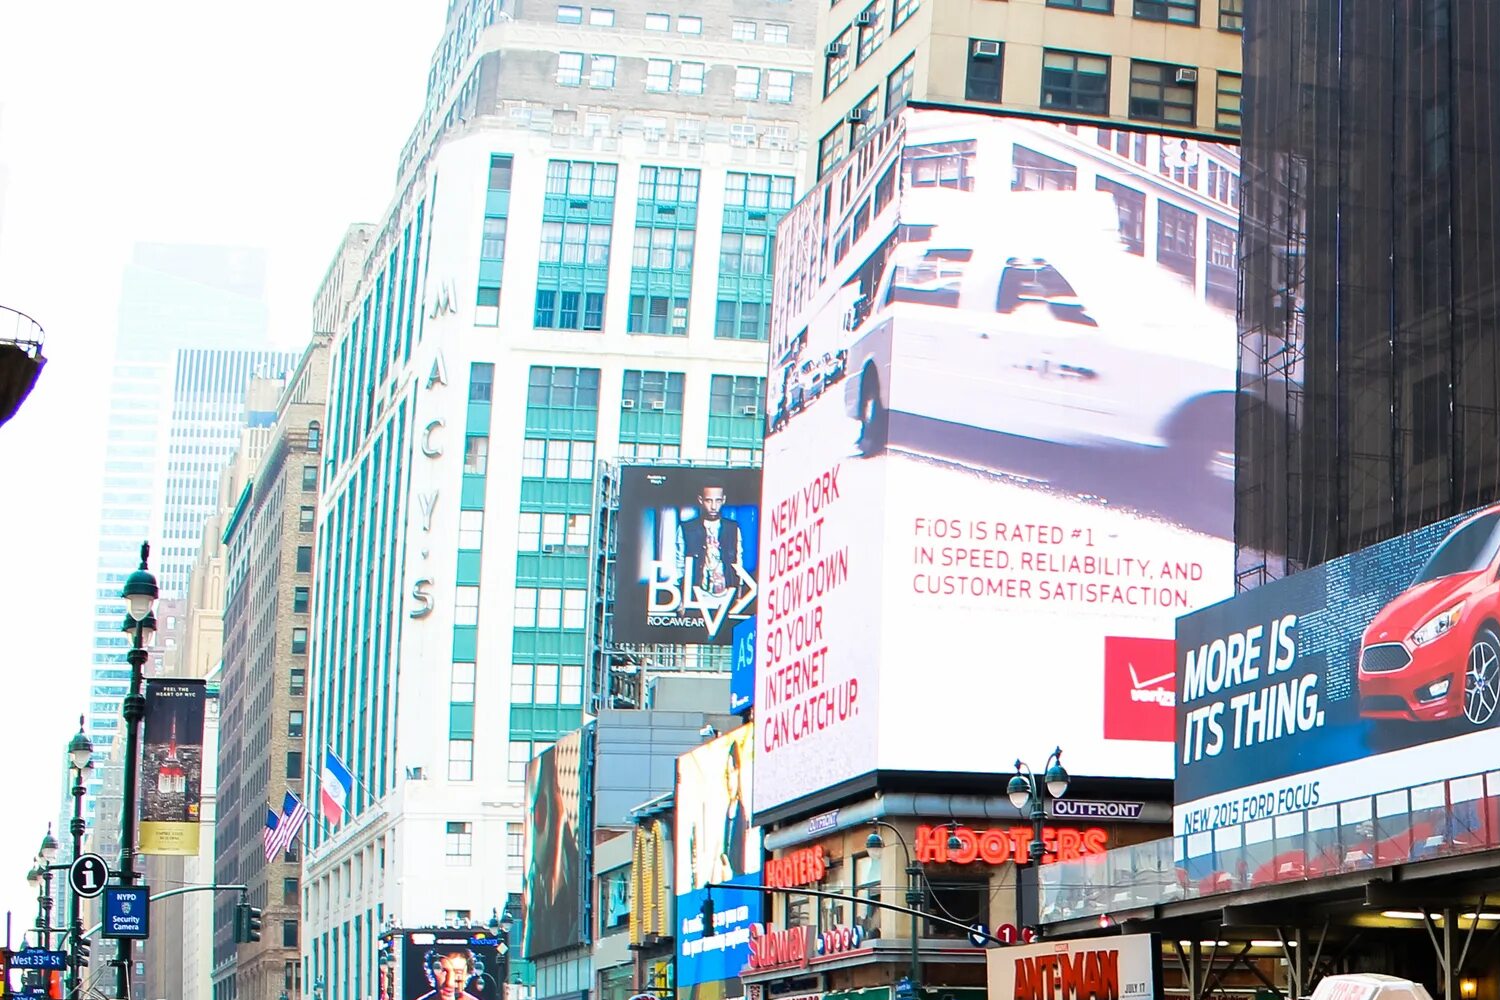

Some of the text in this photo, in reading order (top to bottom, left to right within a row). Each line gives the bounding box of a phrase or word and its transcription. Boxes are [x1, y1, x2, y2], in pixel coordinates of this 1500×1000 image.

[770, 463, 841, 542] NEW YORK
[768, 517, 825, 583] DOESN'T
[914, 518, 1096, 548] FiOS IS RATED #1
[913, 546, 1204, 582] IN SPEED, RELIABILITY, AND
[766, 546, 849, 626] SLOW DOWN
[913, 575, 1194, 609] CUSTOMER SATISFACTION.
[647, 616, 705, 628] ROCAWEAR
[766, 605, 824, 668] SO YOUR
[764, 646, 829, 711] INTERNET
[1181, 614, 1297, 702] MORE IS
[764, 678, 859, 753] CAN CATCH UP.
[1183, 674, 1325, 765] ITS THING.
[1054, 801, 1140, 817] OUTFRONT
[1183, 781, 1320, 836] NEW 2015 FORD FOCUS
[915, 824, 1109, 865] HOOTERS
[765, 845, 826, 888] HOOTERS
[116, 893, 137, 901] NYPD
[112, 915, 140, 924] Security
[113, 923, 139, 931] Camera
[1002, 927, 1011, 943] 1
[11, 955, 32, 965] West
[51, 955, 60, 965] St
[749, 922, 807, 969] Subway
[1125, 983, 1146, 994] JULY 17
